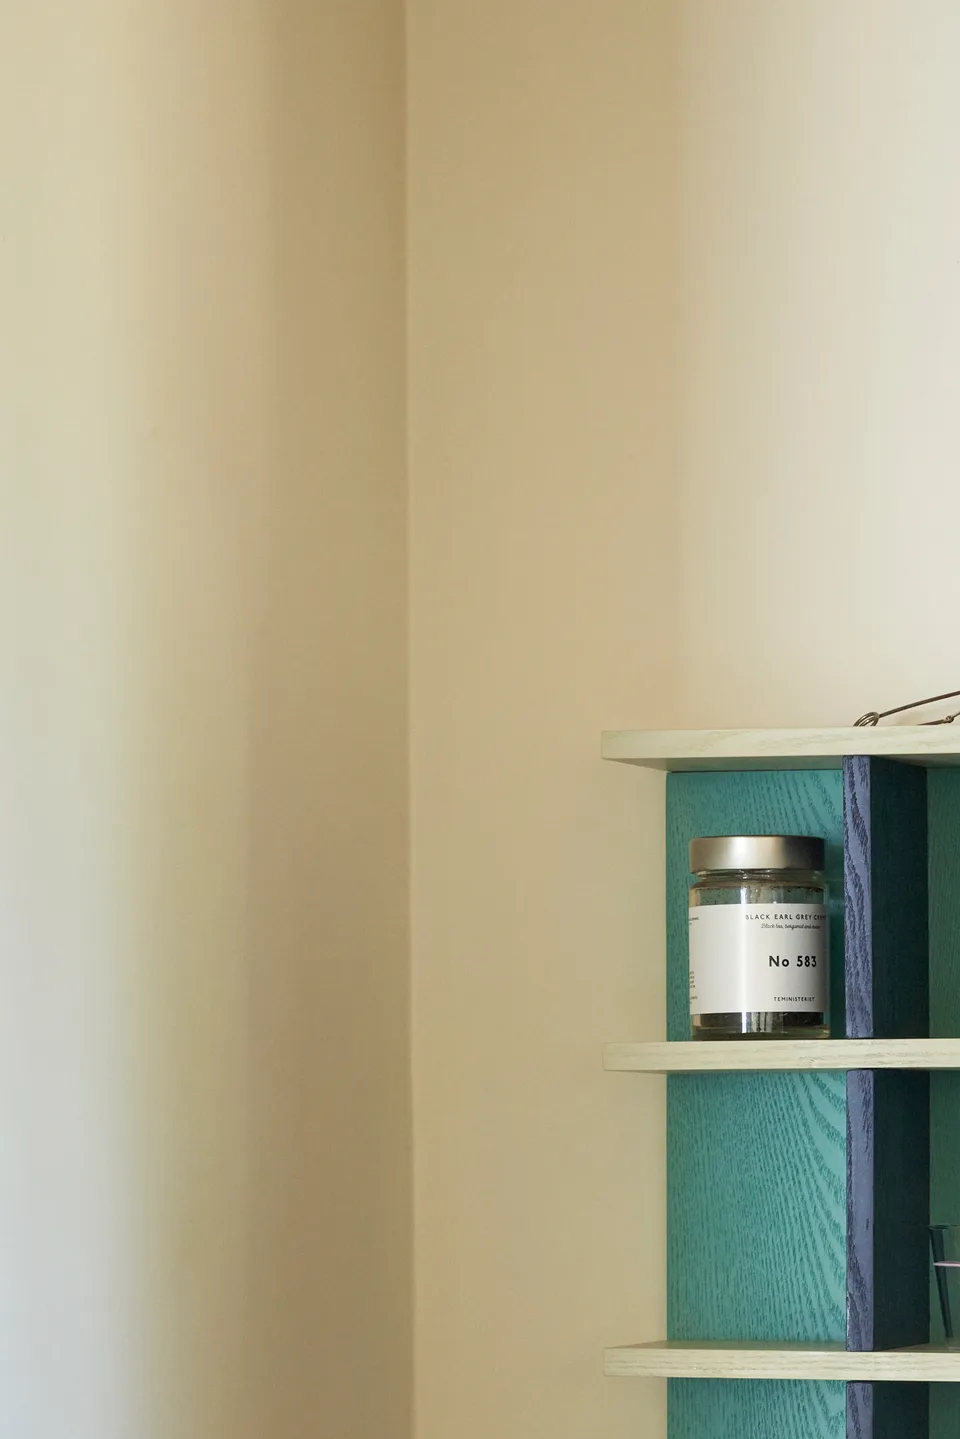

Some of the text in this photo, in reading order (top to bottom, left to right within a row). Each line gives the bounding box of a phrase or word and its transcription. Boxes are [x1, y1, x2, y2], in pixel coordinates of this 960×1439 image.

[745, 913, 771, 921] BLACK
[774, 913, 793, 921] EARL
[795, 913, 812, 921] GREY
[768, 955, 817, 968] No 583
